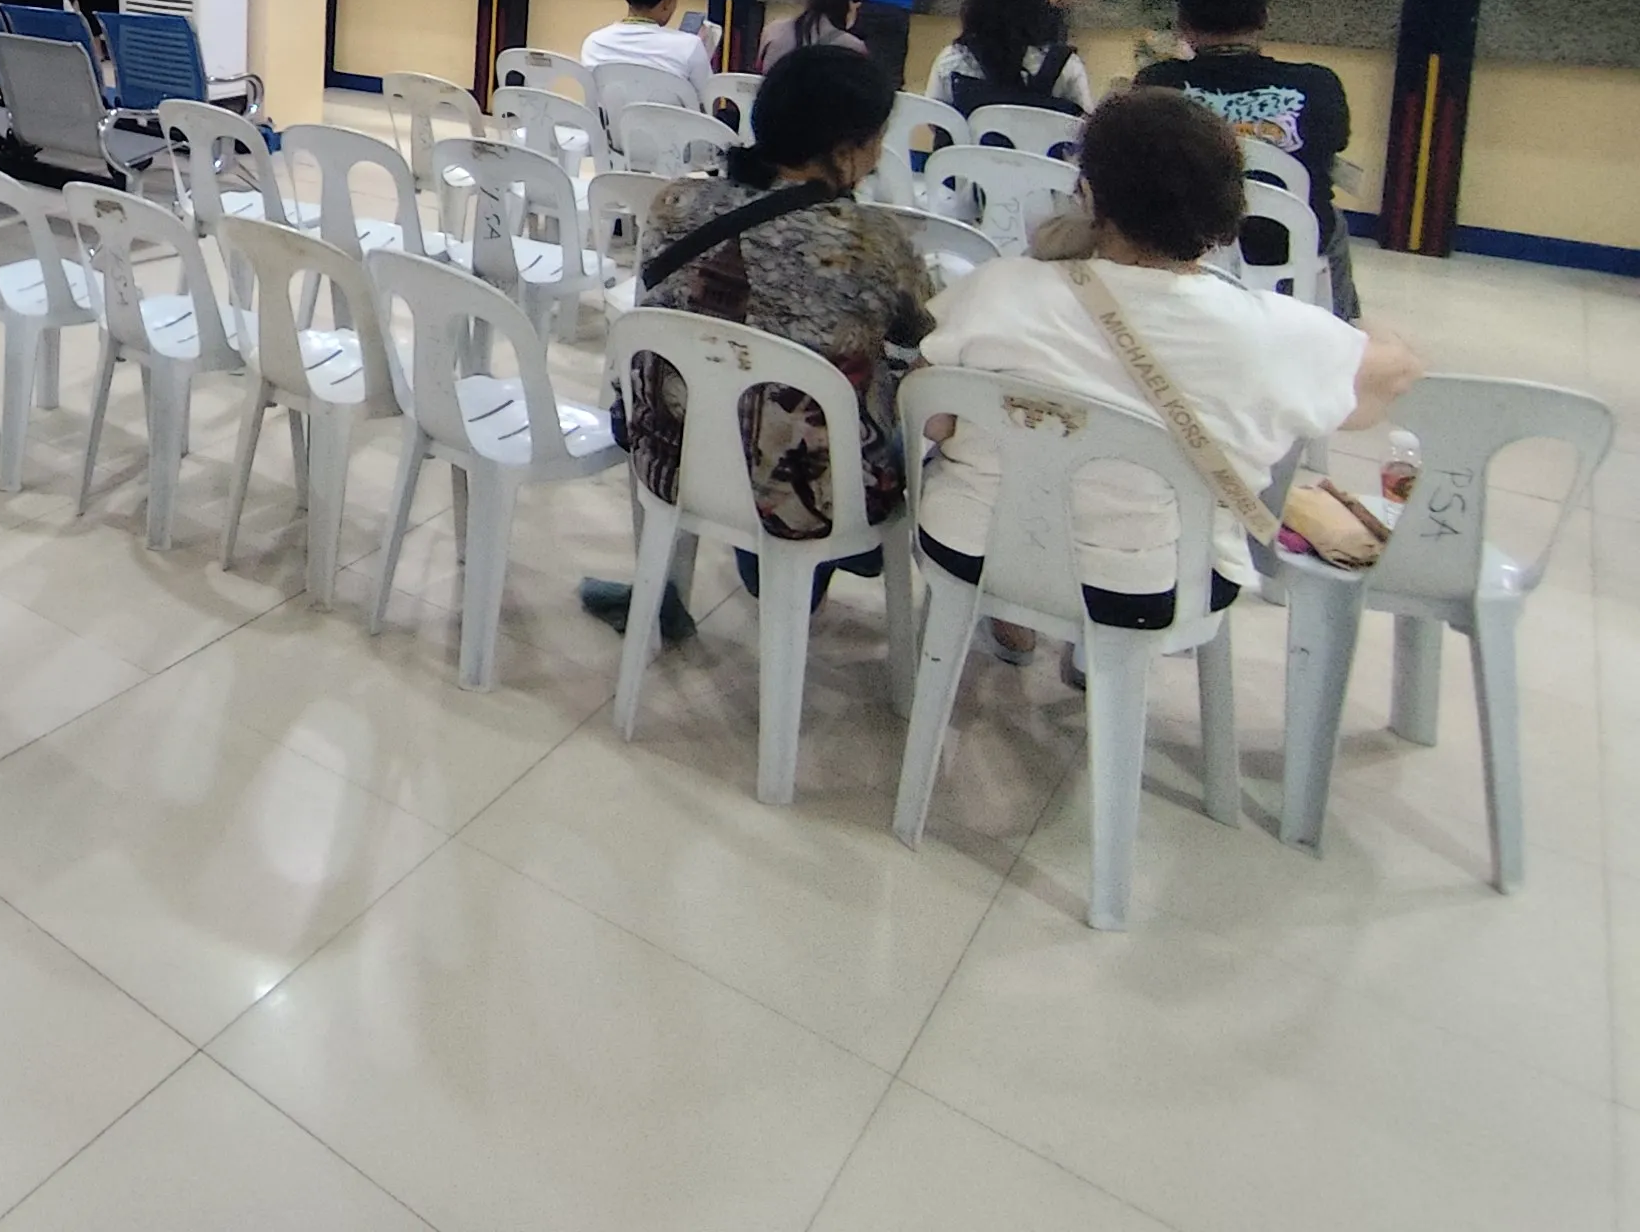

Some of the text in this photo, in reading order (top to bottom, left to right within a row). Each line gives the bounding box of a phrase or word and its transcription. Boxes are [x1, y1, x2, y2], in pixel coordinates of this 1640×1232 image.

[1099, 311, 1211, 450] MICHAEL KORS
[1420, 468, 1474, 542] PSA
